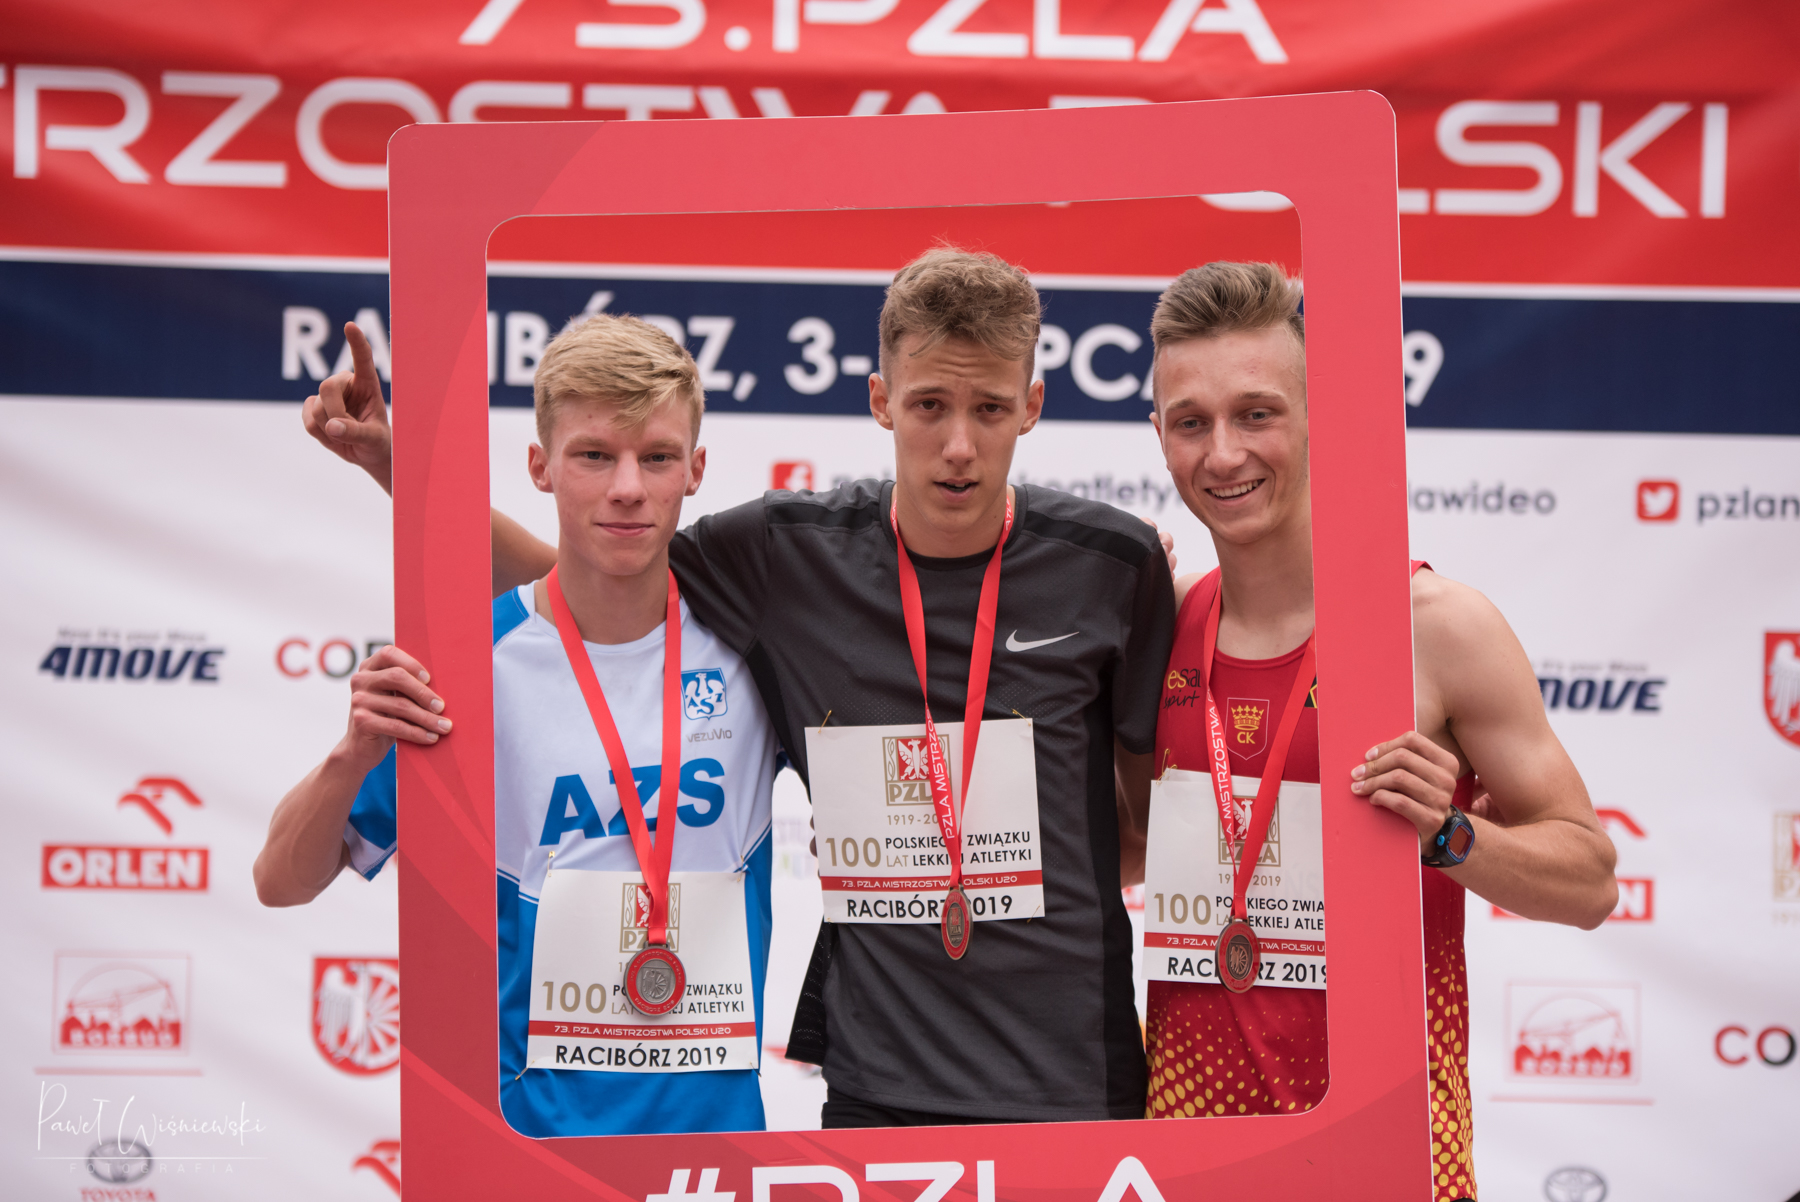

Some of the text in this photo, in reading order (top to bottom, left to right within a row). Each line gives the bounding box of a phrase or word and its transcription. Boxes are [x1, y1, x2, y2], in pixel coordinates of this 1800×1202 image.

[685, 728, 733, 743] VEZUVIO
[1236, 731, 1256, 745] CK
[926, 704, 956, 839] PZLA MISTRZOS
[1208, 706, 1232, 820] MISTRZOSTWA
[539, 757, 726, 847] AZS
[888, 783, 934, 803] PZL
[885, 831, 1031, 850] POLSKIEG ZWIĄZKU
[825, 837, 882, 868] 100
[886, 849, 1032, 868] LAT LEKKIJ ATLETYKI
[47, 847, 200, 888] ORLEN
[841, 880, 856, 888] 73.
[857, 880, 880, 889] PZLA
[963, 877, 993, 886] OLSKI
[995, 875, 1018, 884] U20
[969, 895, 1013, 917] 019
[1153, 892, 1212, 926] 100
[1215, 895, 1289, 911] POKIEGO
[1216, 913, 1231, 926] LA
[1247, 915, 1290, 930] EKKIEJ
[623, 930, 676, 950] PZA
[1166, 937, 1182, 945] 73.
[1183, 938, 1209, 947] PZLA
[1281, 943, 1316, 953] POLSKI
[1317, 945, 1326, 953] U
[542, 980, 608, 1015] 100
[687, 983, 743, 999] ZWIĄZKU
[688, 1001, 745, 1015] ATLETYKI
[554, 1025, 732, 1037] 73. PZLA MISTRZOSTWA POLSKI U20
[555, 1042, 728, 1068] RACIBÓRZ 2019
